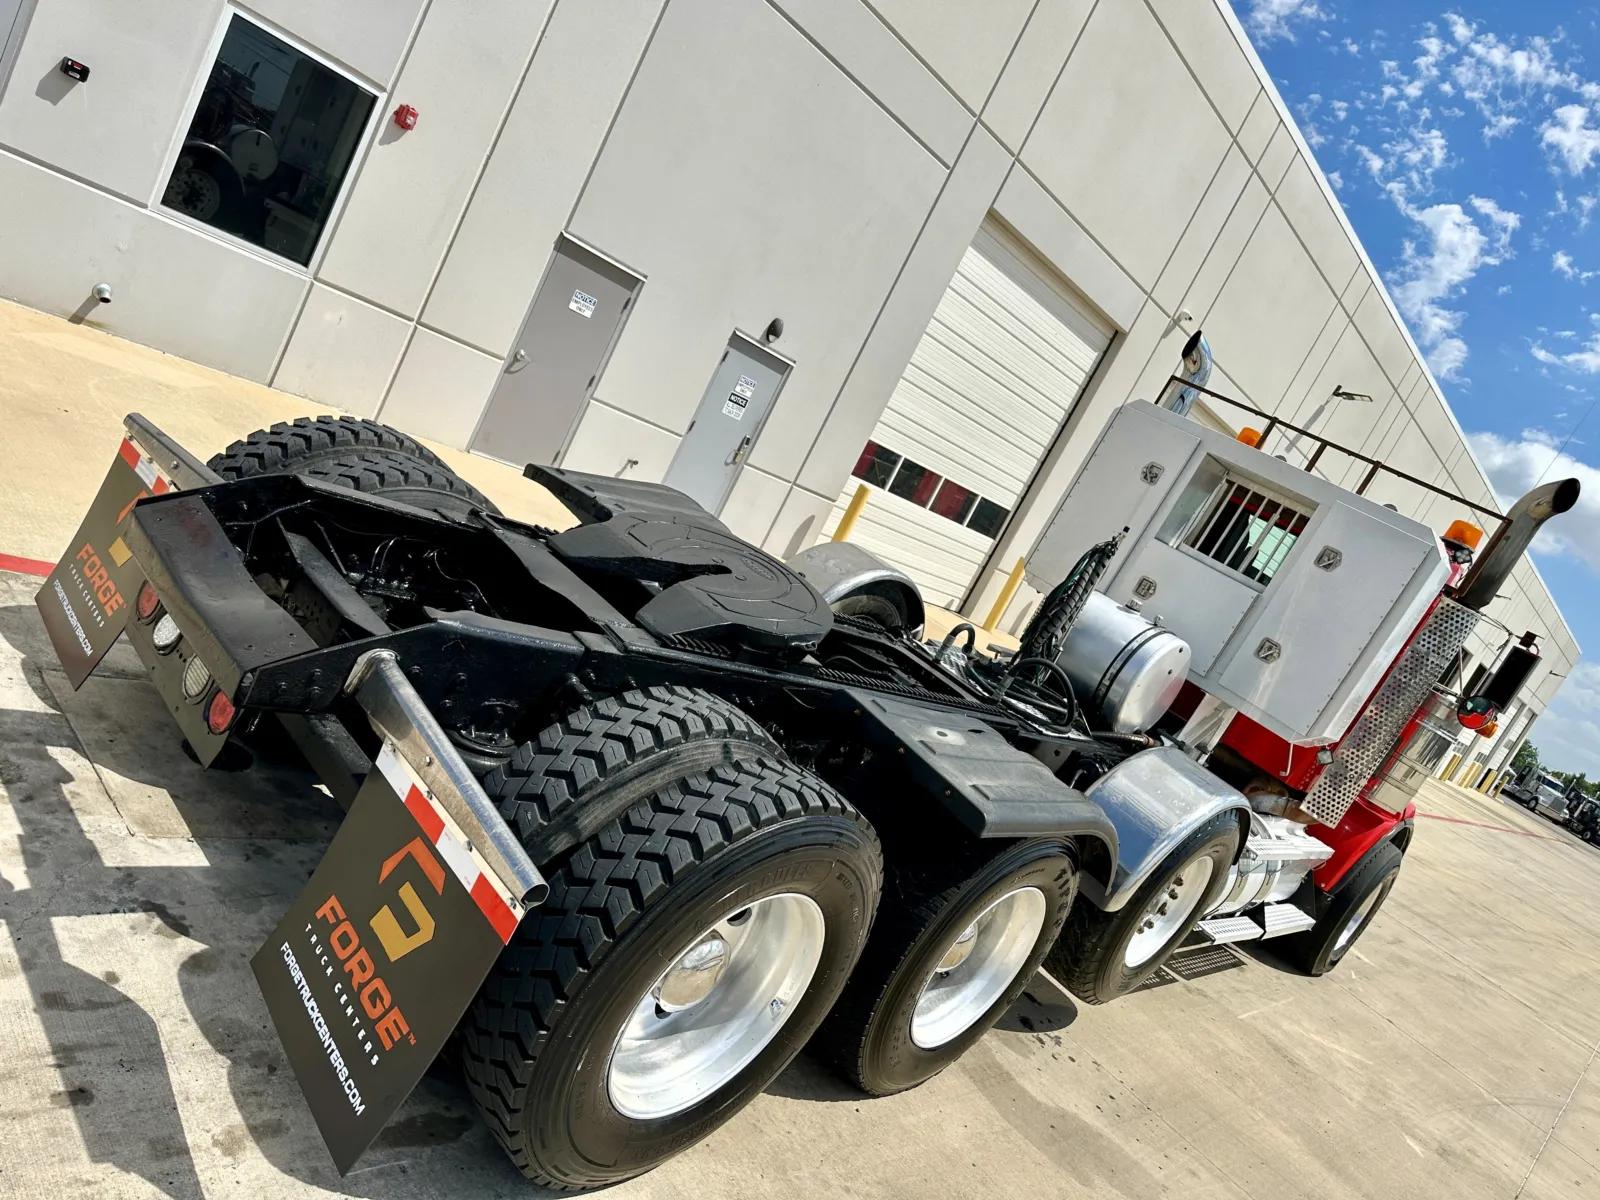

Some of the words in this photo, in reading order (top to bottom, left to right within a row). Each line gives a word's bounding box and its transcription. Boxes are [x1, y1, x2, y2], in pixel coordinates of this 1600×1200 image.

[574, 291, 597, 306] NOTICE
[730, 394, 747, 406] NOTICE
[68, 563, 83, 590] TRUCK
[82, 590, 105, 628] CENTERS
[76, 543, 124, 617] FORGE
[280, 941, 366, 1116] FORGETRUCKCENTERS.COM
[304, 923, 334, 977] TRUCK
[334, 981, 379, 1066] CENTERS
